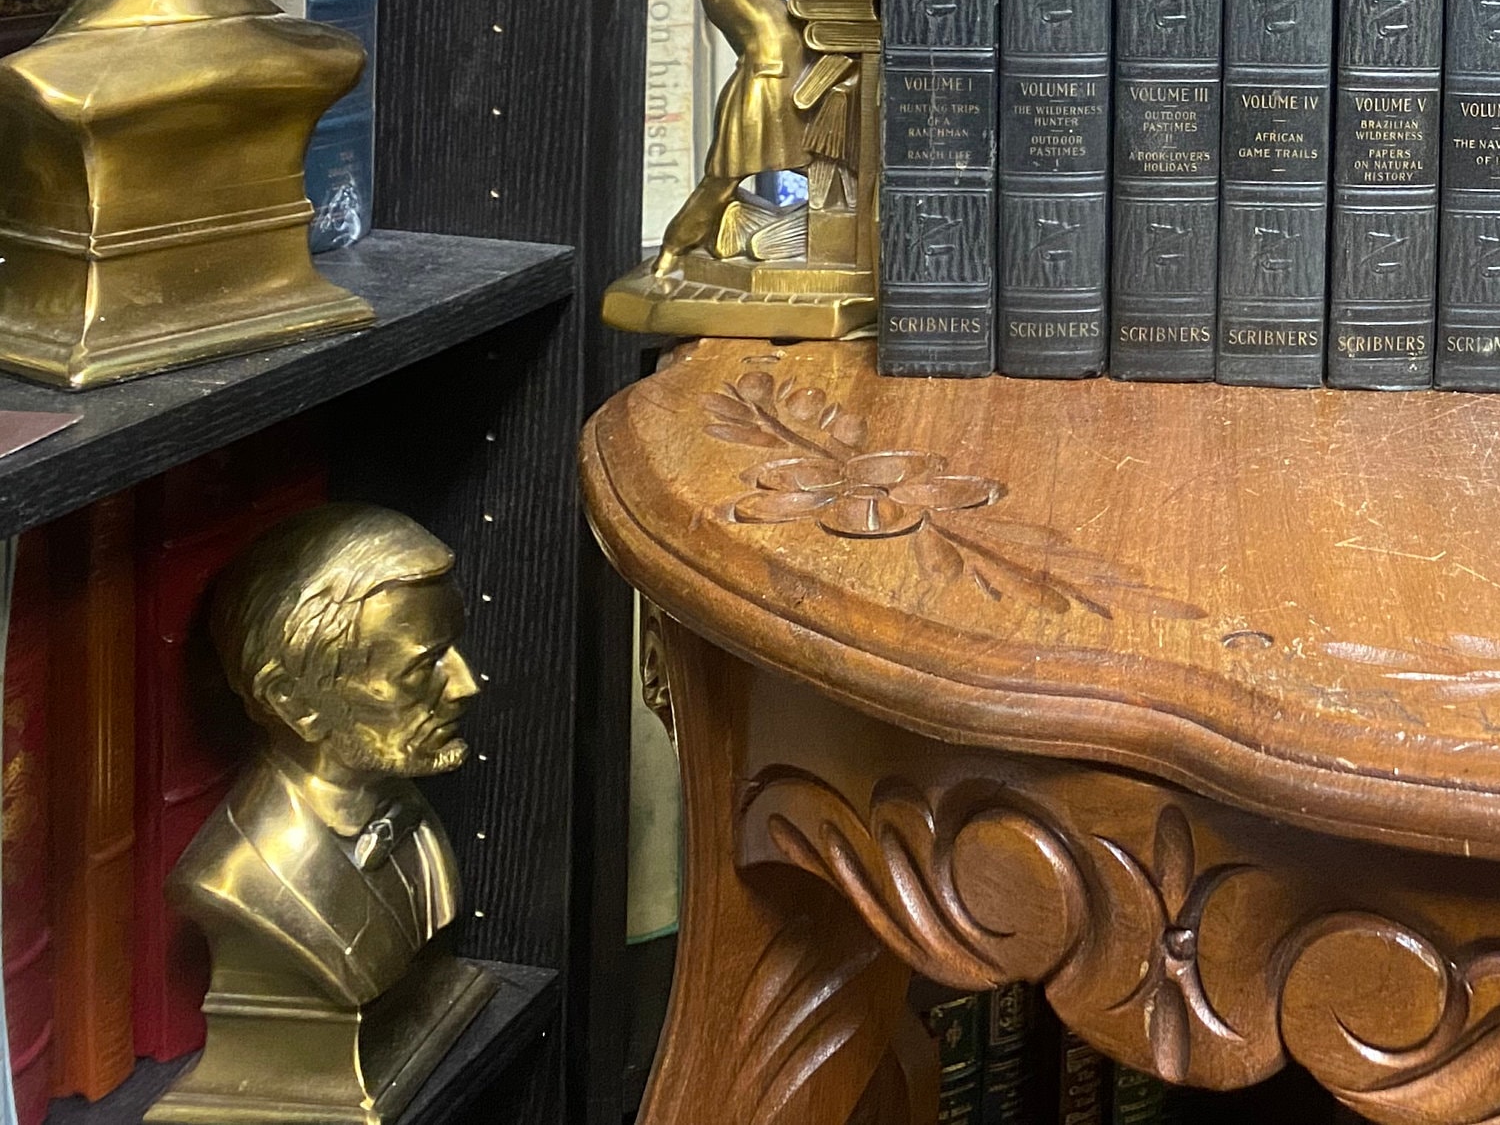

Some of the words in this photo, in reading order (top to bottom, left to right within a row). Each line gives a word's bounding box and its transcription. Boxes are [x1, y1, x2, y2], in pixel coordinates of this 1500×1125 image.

[650, 0, 671, 45] on
[648, 58, 682, 184] himself
[1453, 138, 1475, 150] THE
[1475, 155, 1492, 166] OF
